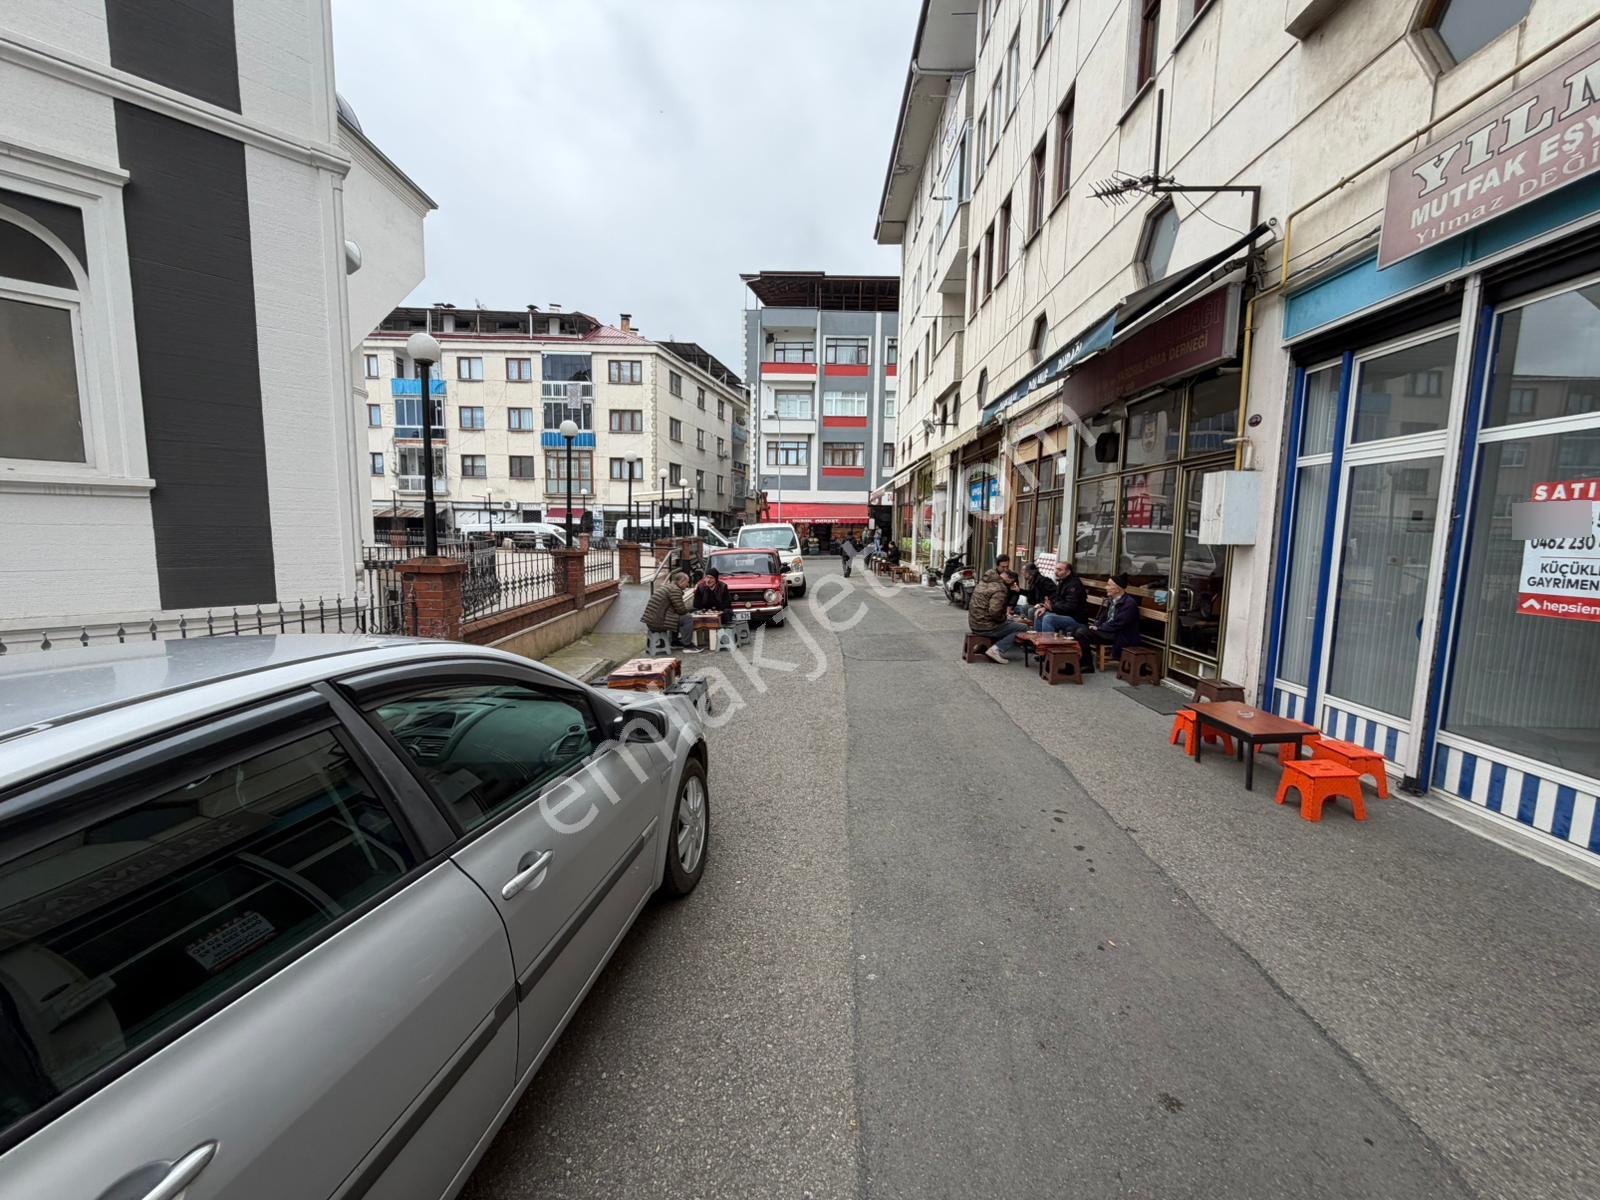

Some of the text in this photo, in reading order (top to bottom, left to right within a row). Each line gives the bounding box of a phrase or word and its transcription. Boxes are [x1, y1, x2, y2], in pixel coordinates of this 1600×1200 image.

[1410, 152, 1527, 229] MUTFAK
[1415, 195, 1504, 245] Yılmaz
[1535, 482, 1596, 501] SATI
[1540, 560, 1600, 578] KÜÇÜKL
